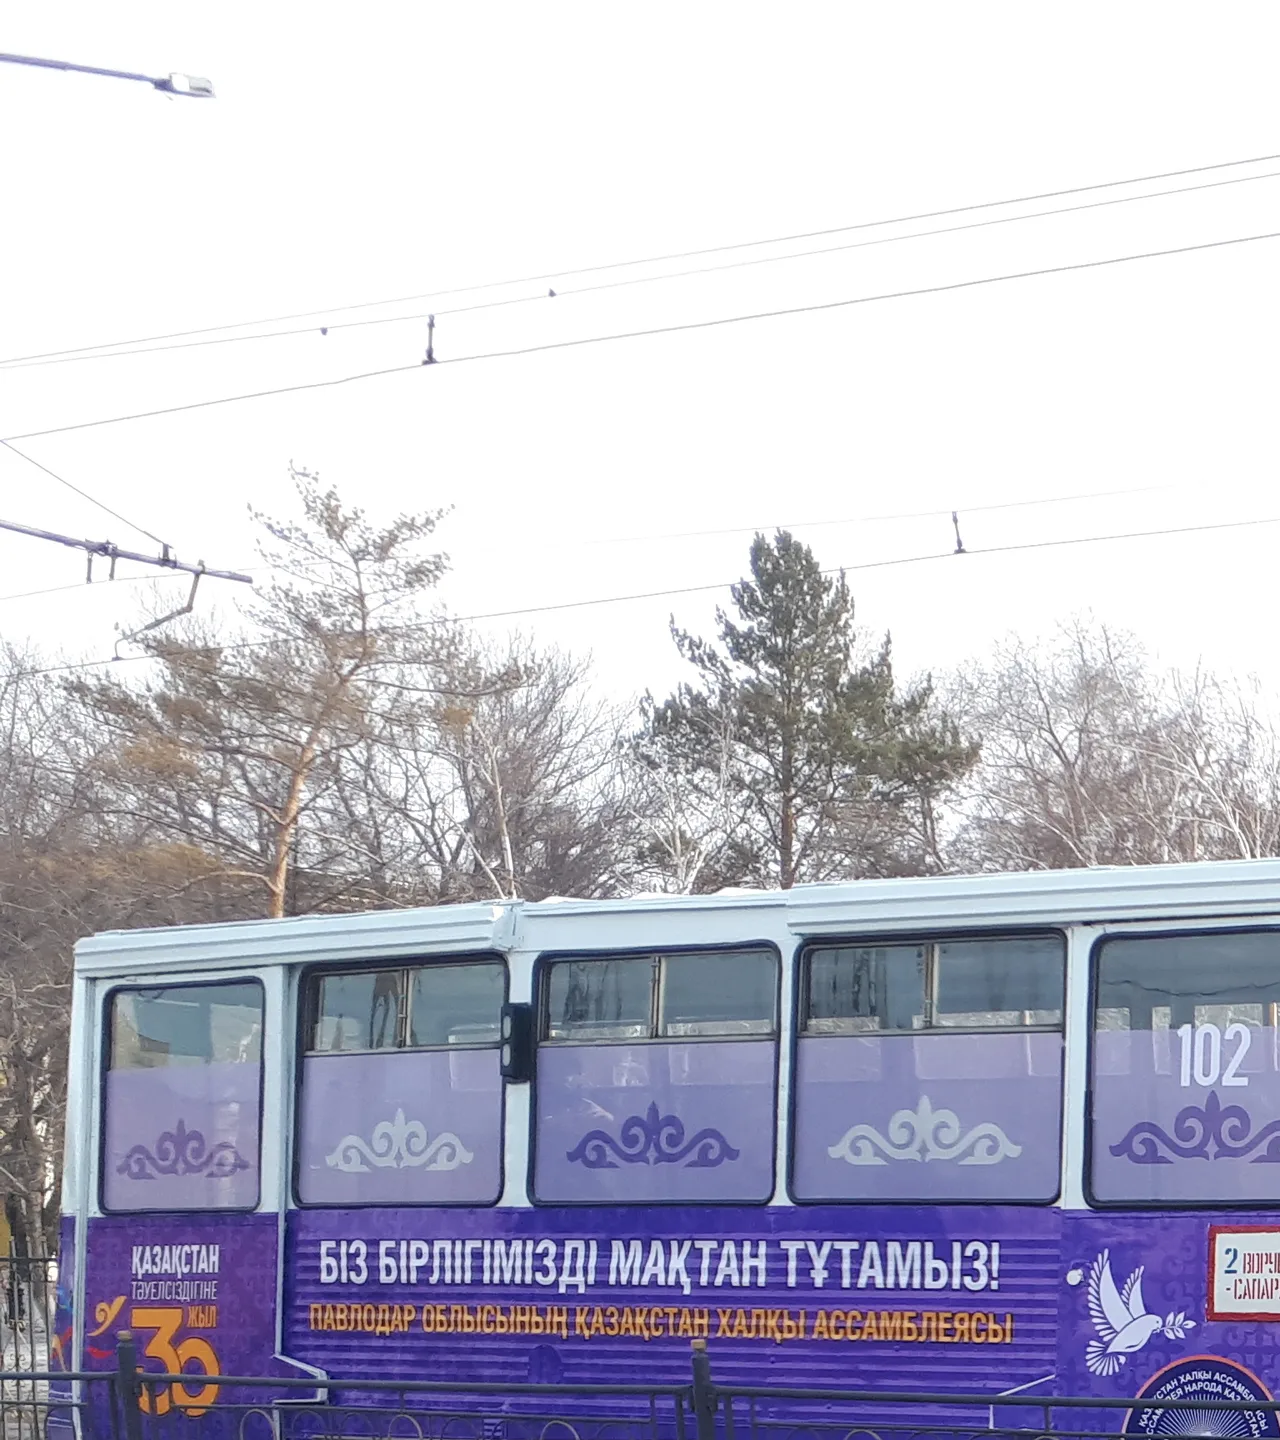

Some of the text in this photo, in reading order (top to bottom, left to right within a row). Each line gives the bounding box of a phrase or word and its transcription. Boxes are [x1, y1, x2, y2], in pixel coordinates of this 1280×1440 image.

[1177, 1023, 1251, 1087] 102
[131, 1244, 220, 1280] ҚАЗАҚСТАН
[319, 1238, 1000, 1295] БІЗ БІРЛІГІМІЗДІ МАҚТАН ТҰТАМЫЗ!
[1224, 1247, 1239, 1274] 2
[131, 1280, 219, 1303] ТӘУЕЛСІЗДІГІНЕ
[309, 1303, 1013, 1344] ПАВЛОДАР ОБЛЫСЫНЫҢ ҚАЗАҚСТАН ХАЛҚЫ АССАМБЛЕЯСЫ
[130, 1305, 222, 1417] 30 ЖЫЛ
[1178, 1370, 1212, 1384] ХАЛҚЫ
[1213, 1371, 1269, 1431] АССАМБЛСЫ
[1184, 1381, 1222, 1394] НАРОДА
